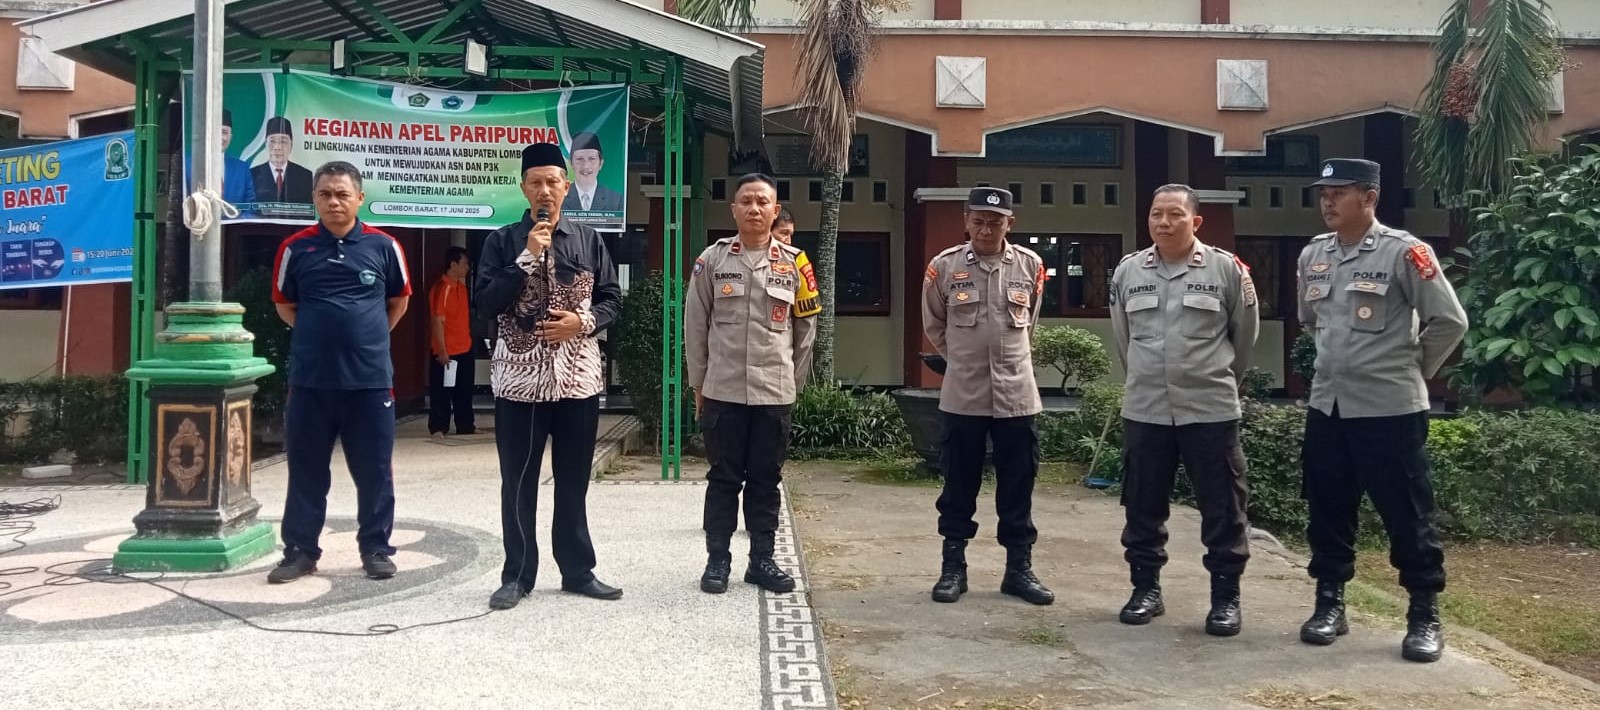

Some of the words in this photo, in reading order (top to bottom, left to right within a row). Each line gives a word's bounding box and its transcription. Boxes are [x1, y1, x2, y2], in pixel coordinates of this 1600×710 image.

[304, 118, 393, 140] KEGIATAN
[398, 123, 445, 142] APEL
[450, 125, 559, 144] PARIPURNA
[304, 141, 312, 150] DI
[314, 141, 366, 153] LINGKUNGAN
[368, 144, 422, 156] KEMENTERIAN
[423, 147, 451, 157] AGAMA
[452, 147, 497, 159] KABUPATEN
[500, 150, 522, 159] LOMB
[365, 158, 391, 169] UNTUK
[393, 159, 447, 170] MEWUJUDKAN
[448, 161, 463, 171] ASN
[466, 162, 482, 172] DAN
[484, 163, 499, 172] P3K
[377, 171, 439, 183] MENINGKATKAN
[441, 175, 459, 184] LIMA
[461, 175, 491, 185] BUDAYA
[493, 176, 517, 185] KERJA
[4, 184, 69, 210] BARAT
[389, 184, 444, 196] KEMENTERIAN
[446, 187, 474, 197] AGAMA
[383, 204, 413, 213] LOMBOK
[415, 205, 439, 214] BARAT,
[1353, 271, 1388, 280] POLRI
[1187, 283, 1218, 293] POLRI
